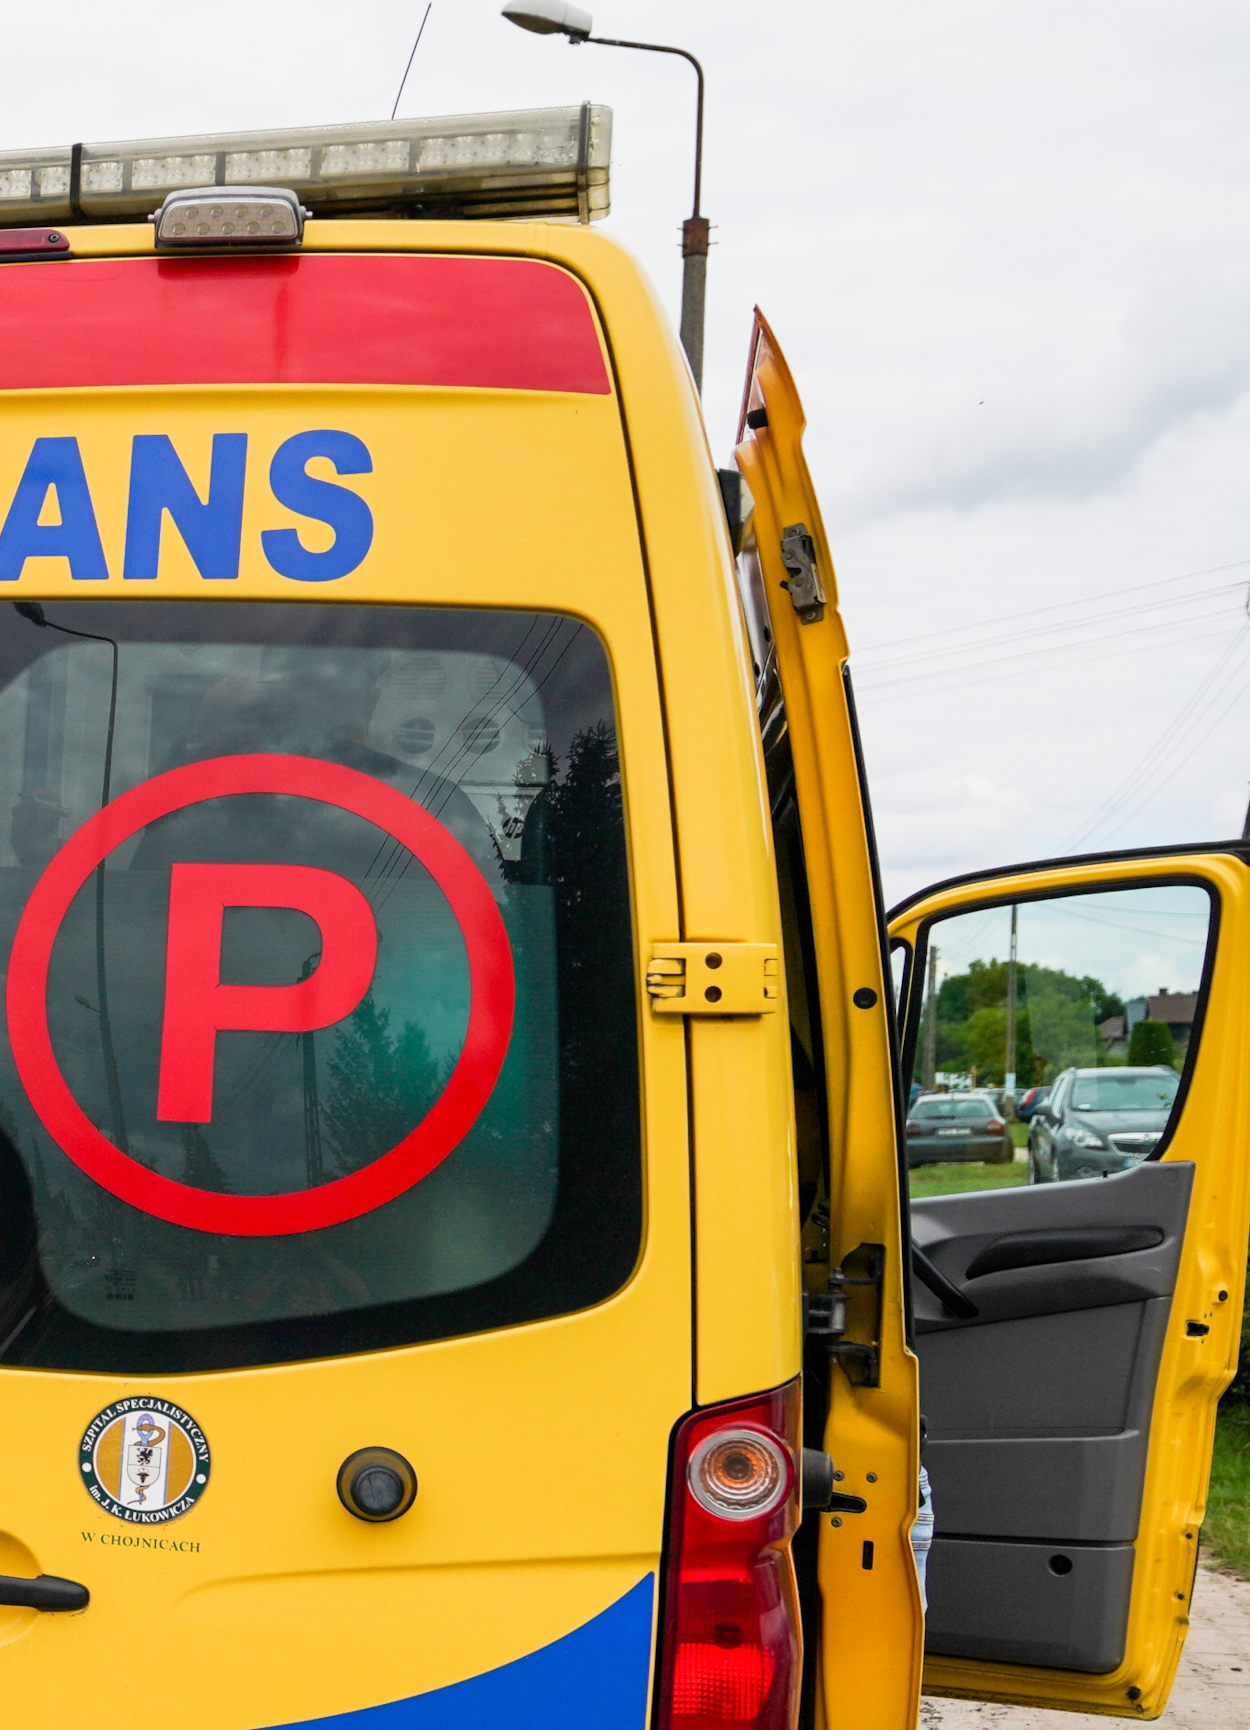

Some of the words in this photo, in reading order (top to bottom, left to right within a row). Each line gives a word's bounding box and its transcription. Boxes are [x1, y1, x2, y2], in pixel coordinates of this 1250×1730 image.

[157, 862, 378, 1124] P
[82, 1409, 117, 1452] SZPITAL
[116, 1398, 209, 1463] SPECJALISTYCZNY
[100, 1499, 111, 1510] J.
[110, 1504, 123, 1517] K.
[81, 1532, 96, 1543] W
[100, 1533, 201, 1553] CHOJNICACH
